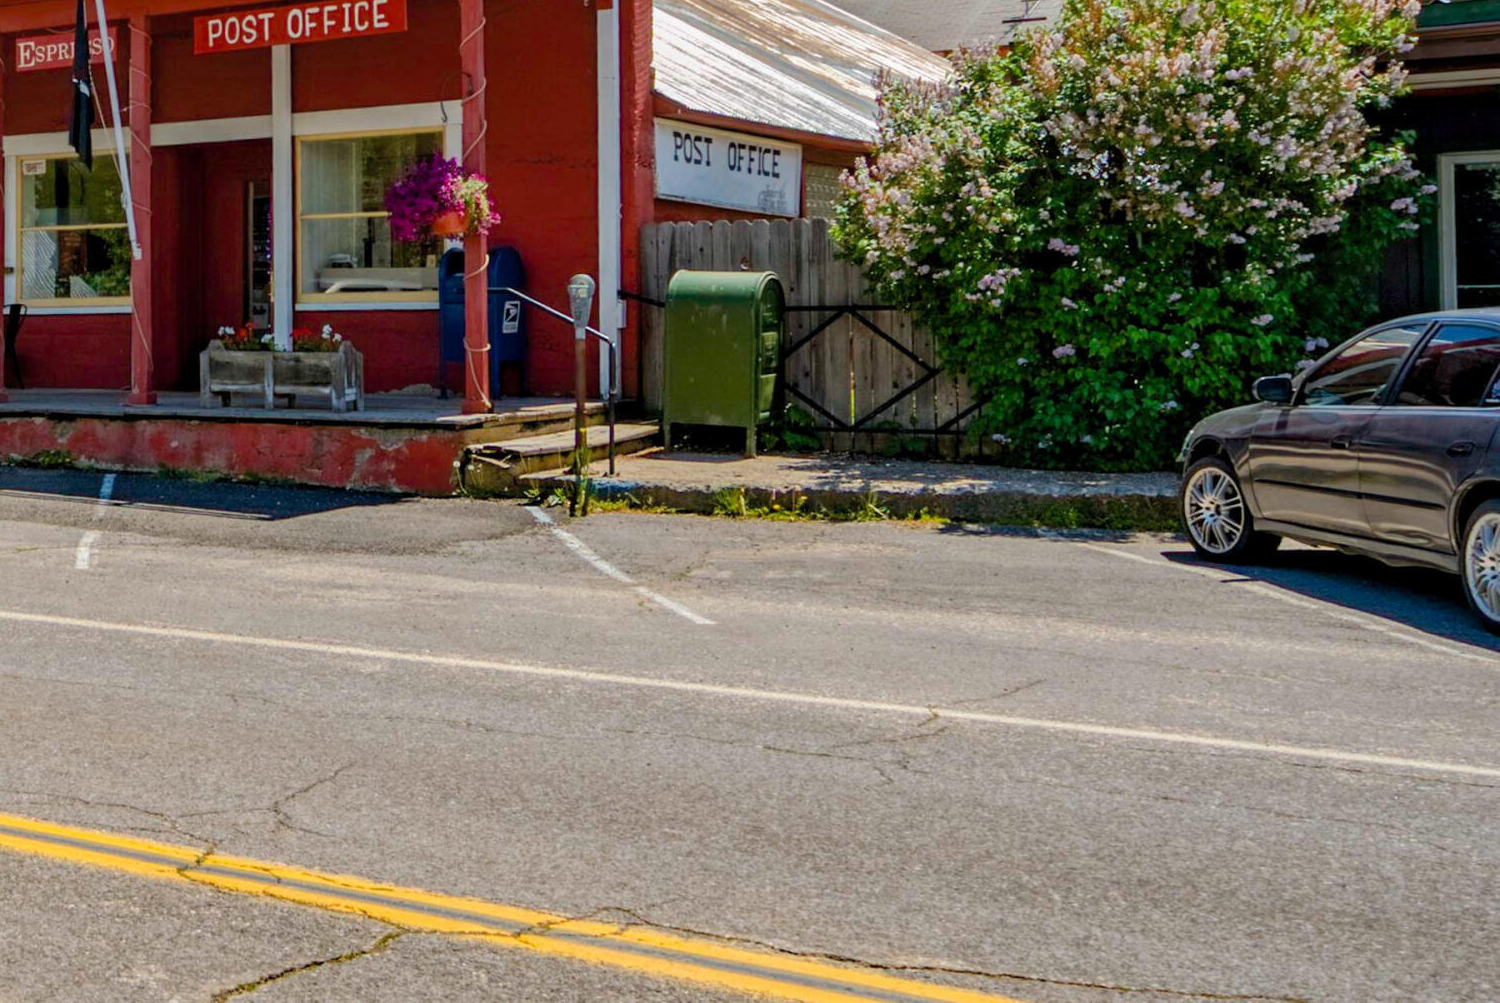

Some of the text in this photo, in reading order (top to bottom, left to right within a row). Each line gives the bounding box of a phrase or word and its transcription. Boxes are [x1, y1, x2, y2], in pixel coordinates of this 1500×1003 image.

[208, 12, 275, 47] POST
[673, 131, 781, 179] POST OFFICE
